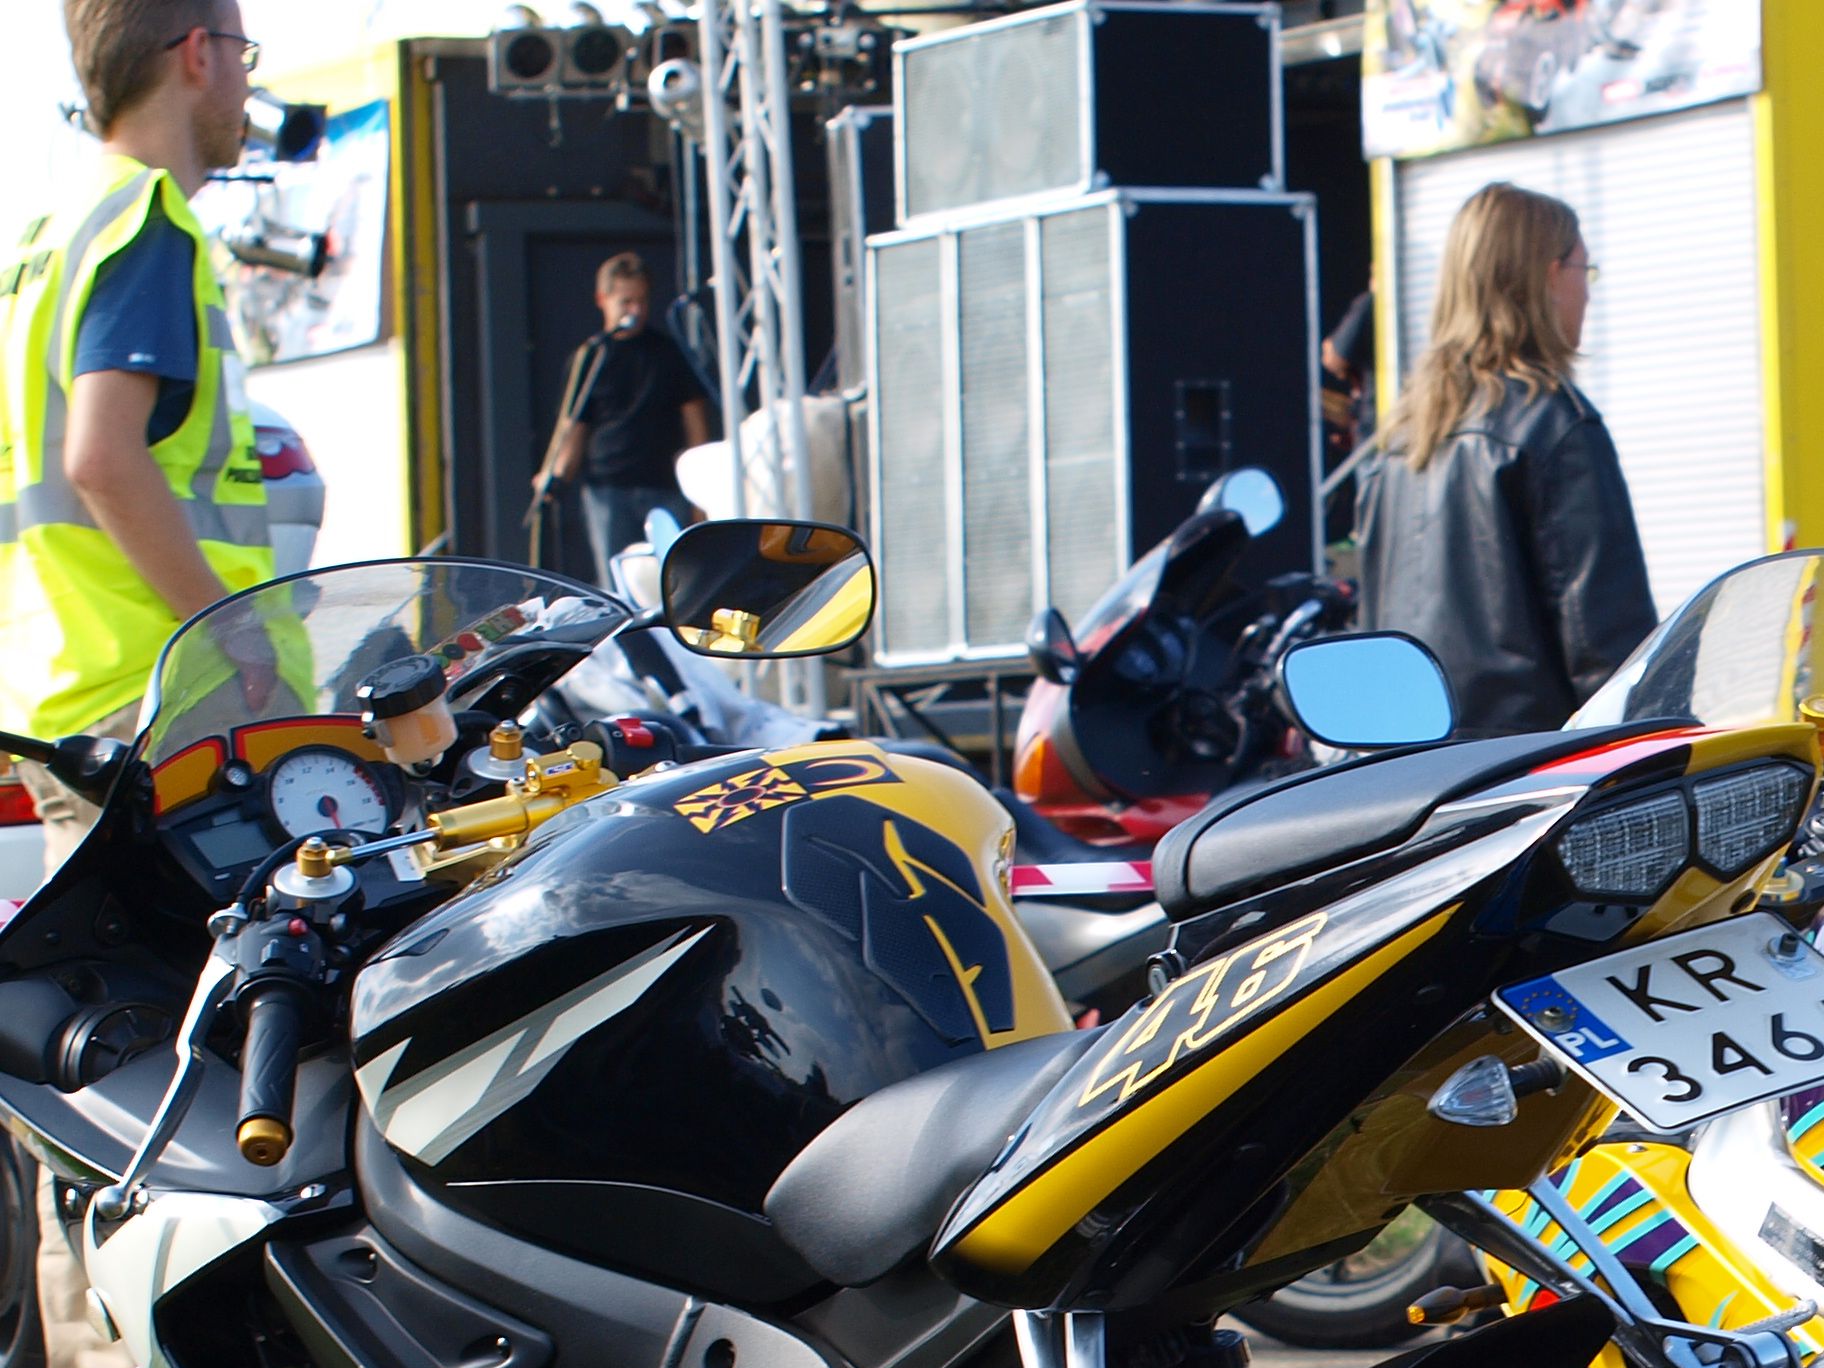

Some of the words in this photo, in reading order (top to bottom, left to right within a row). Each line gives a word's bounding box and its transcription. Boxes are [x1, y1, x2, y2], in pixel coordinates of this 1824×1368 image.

[1078, 911, 1329, 1107] 46
[1604, 948, 1768, 1023] KR
[1553, 1026, 1620, 1059] PL
